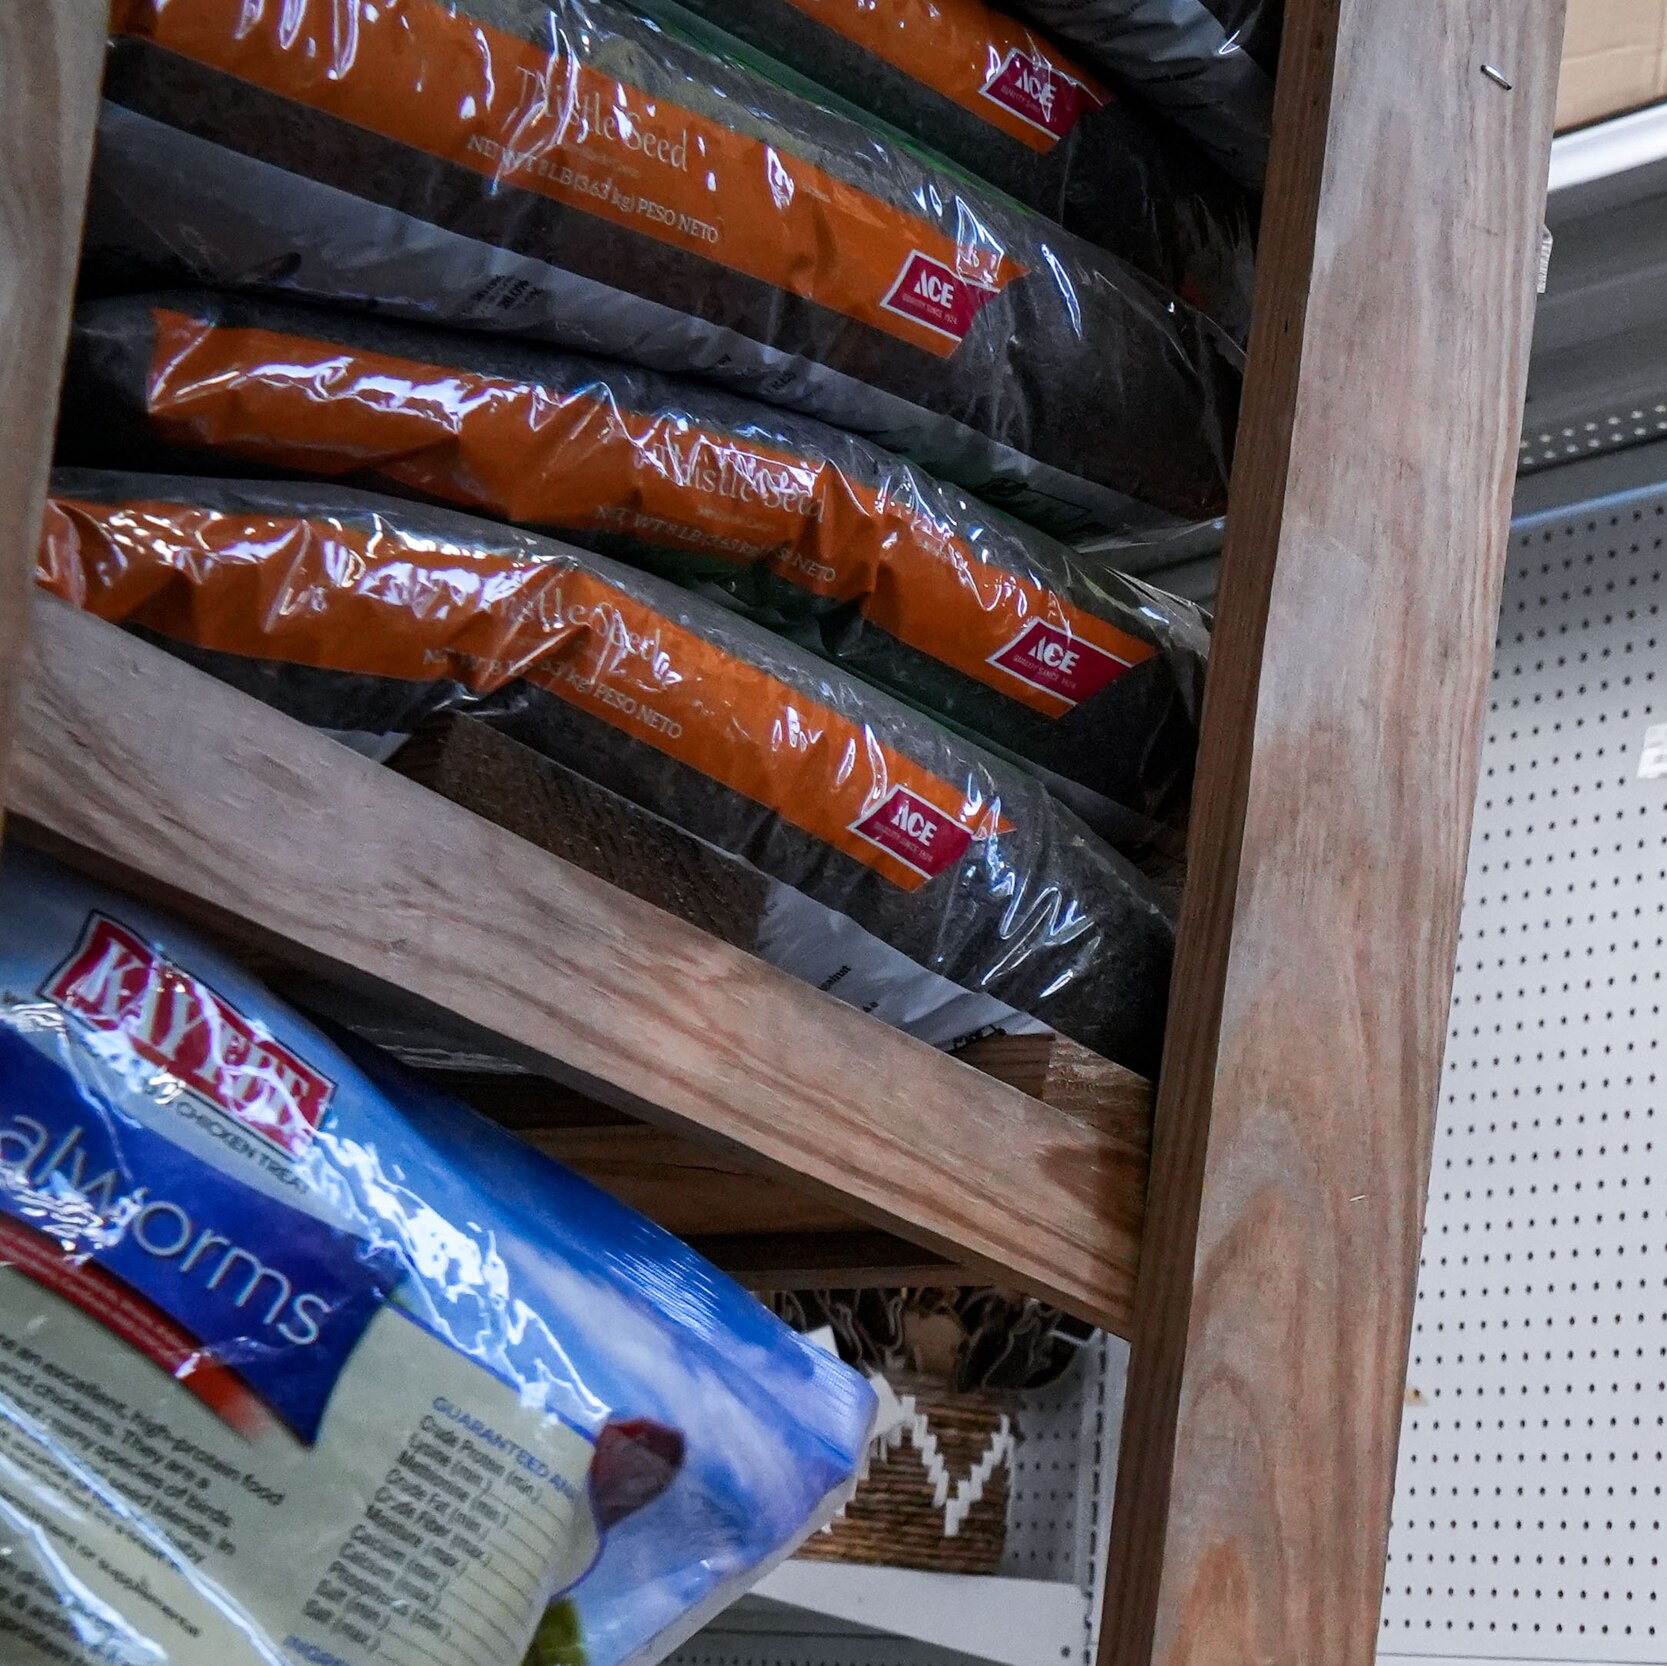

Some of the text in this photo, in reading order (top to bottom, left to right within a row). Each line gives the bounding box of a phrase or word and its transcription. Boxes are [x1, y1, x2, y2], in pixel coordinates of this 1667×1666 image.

[1013, 67, 1057, 108] ACE
[623, 112, 689, 173] Seed
[636, 197, 677, 227] PESO
[678, 212, 720, 245] NETO
[913, 268, 955, 310] ACE
[793, 552, 837, 584] NETO
[1027, 635, 1081, 676] ACE
[593, 686, 638, 715] PESO
[636, 702, 683, 740] NETO
[889, 800, 939, 847] ACE
[123, 1427, 164, 1466] They
[431, 1396, 550, 1478] GUARANTEED
[241, 1473, 285, 1507] food
